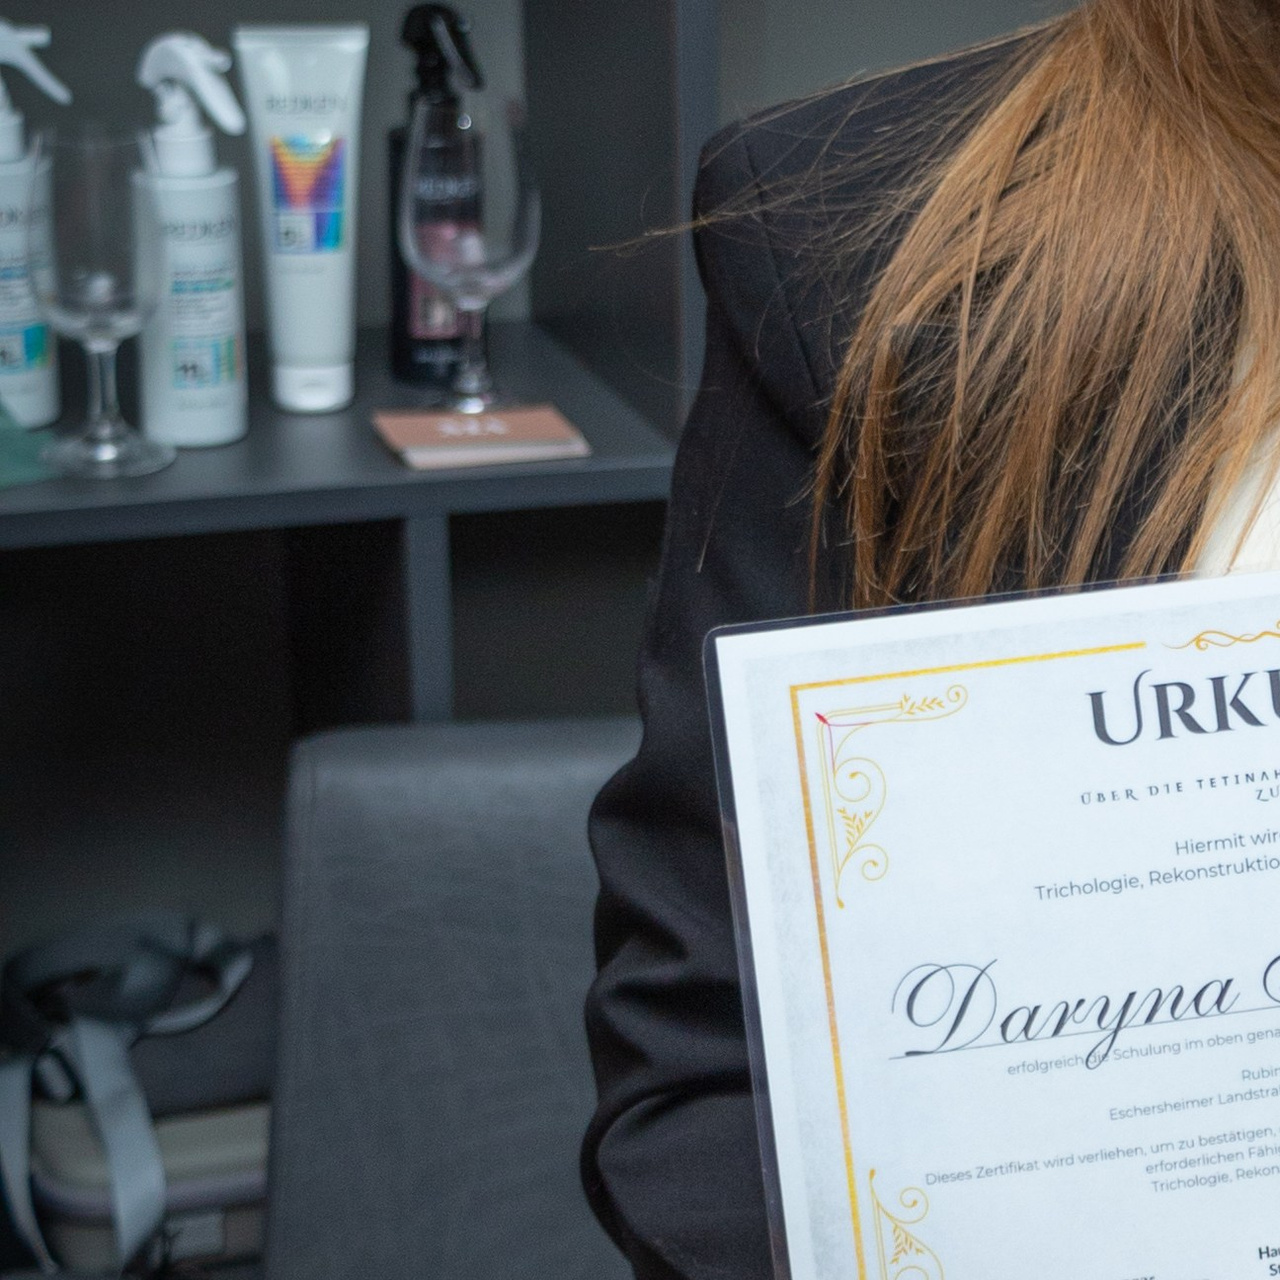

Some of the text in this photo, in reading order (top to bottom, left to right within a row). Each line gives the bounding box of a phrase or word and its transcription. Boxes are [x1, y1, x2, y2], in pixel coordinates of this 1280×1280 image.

[1146, 781, 1183, 796] DIE
[1174, 832, 1246, 856] Hiermit
[1033, 873, 1144, 900] Trichologie,
[892, 959, 1239, 1069] Daryna
[1007, 1055, 1084, 1075] erfolgreich
[1113, 1042, 1181, 1061] Schulung
[1184, 1038, 1204, 1051] im
[1205, 1033, 1243, 1047] oben
[1108, 1096, 1214, 1121] Eschersheimer
[924, 1169, 973, 1186] Dieses
[975, 1159, 1040, 1179] Zertifikat
[1042, 1153, 1075, 1168] wird
[1076, 1146, 1147, 1164] verliehen,
[1149, 1141, 1175, 1154] um
[1177, 1138, 1195, 1151] zu
[1197, 1126, 1277, 1147] bestätigen,
[1144, 1151, 1245, 1174] erforderlichen
[1150, 1171, 1233, 1192] Trichologie,
